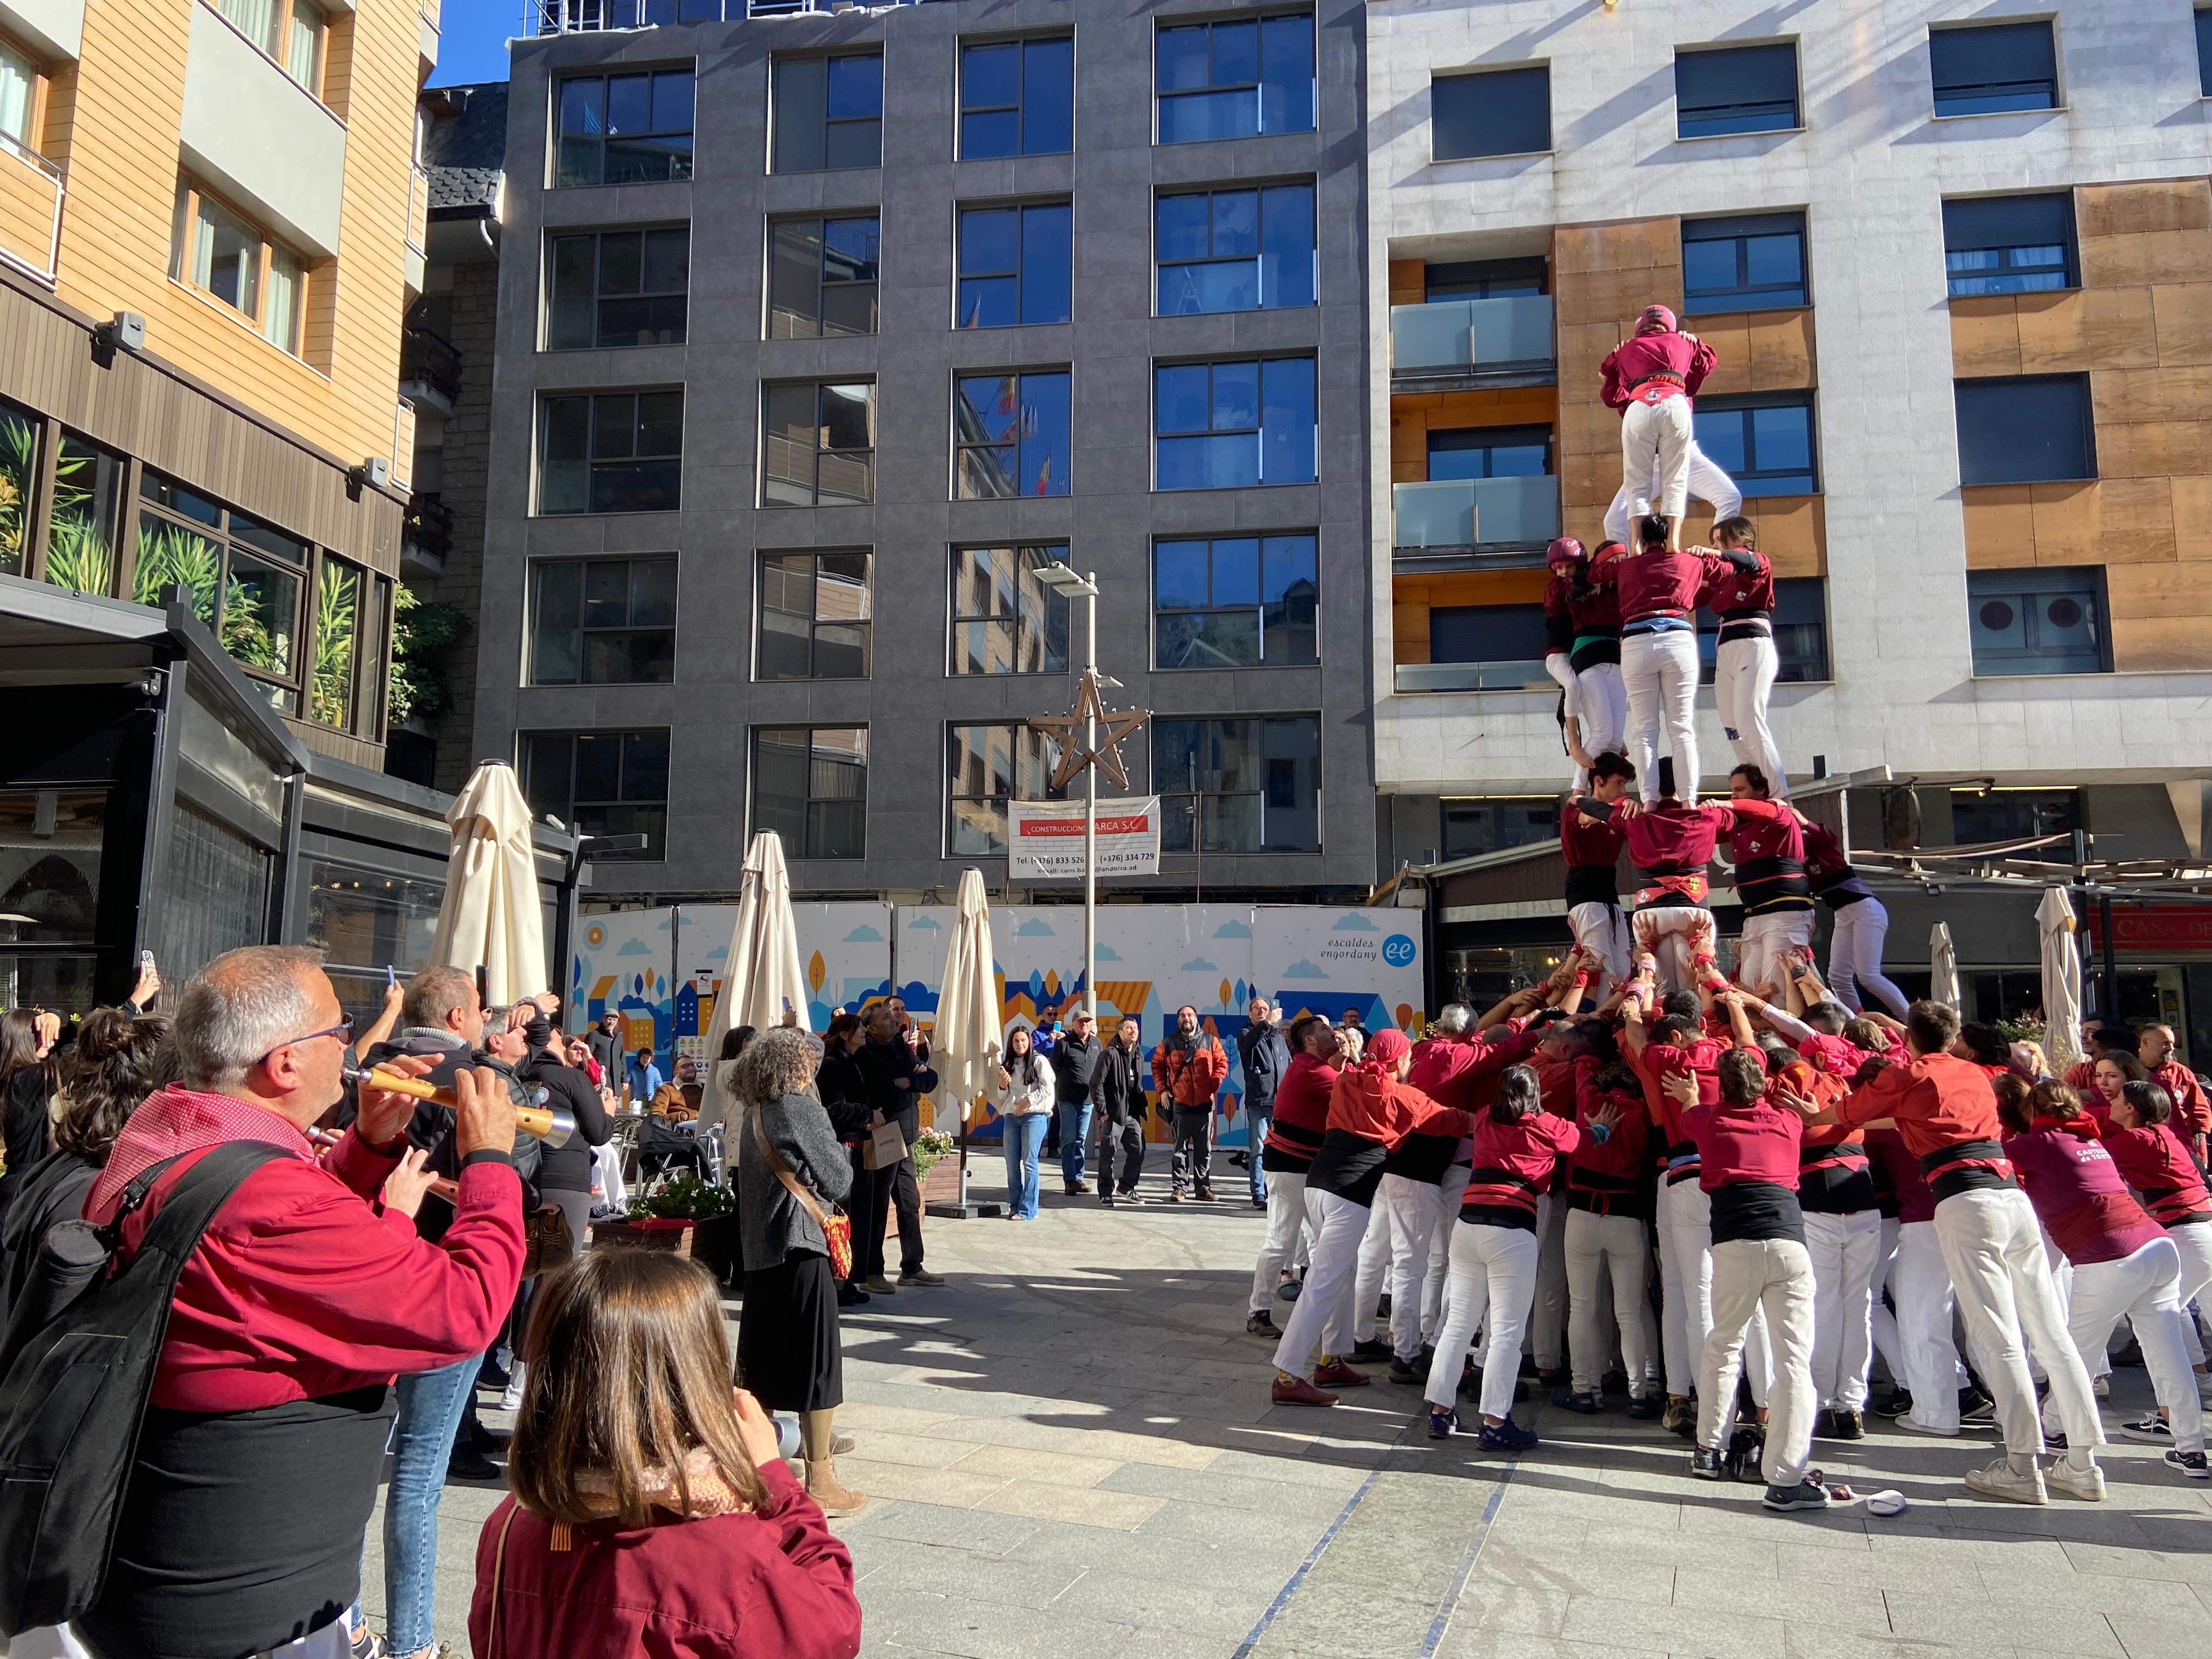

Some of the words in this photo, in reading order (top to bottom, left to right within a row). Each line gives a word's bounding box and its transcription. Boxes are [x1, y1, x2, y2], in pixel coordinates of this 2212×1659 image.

[1094, 822, 1119, 831] ARCA
[1100, 854, 1123, 864] (+376)
[2117, 919, 2179, 936] CASA
[1321, 949, 1377, 961] engordany
[1386, 942, 1411, 960] ee
